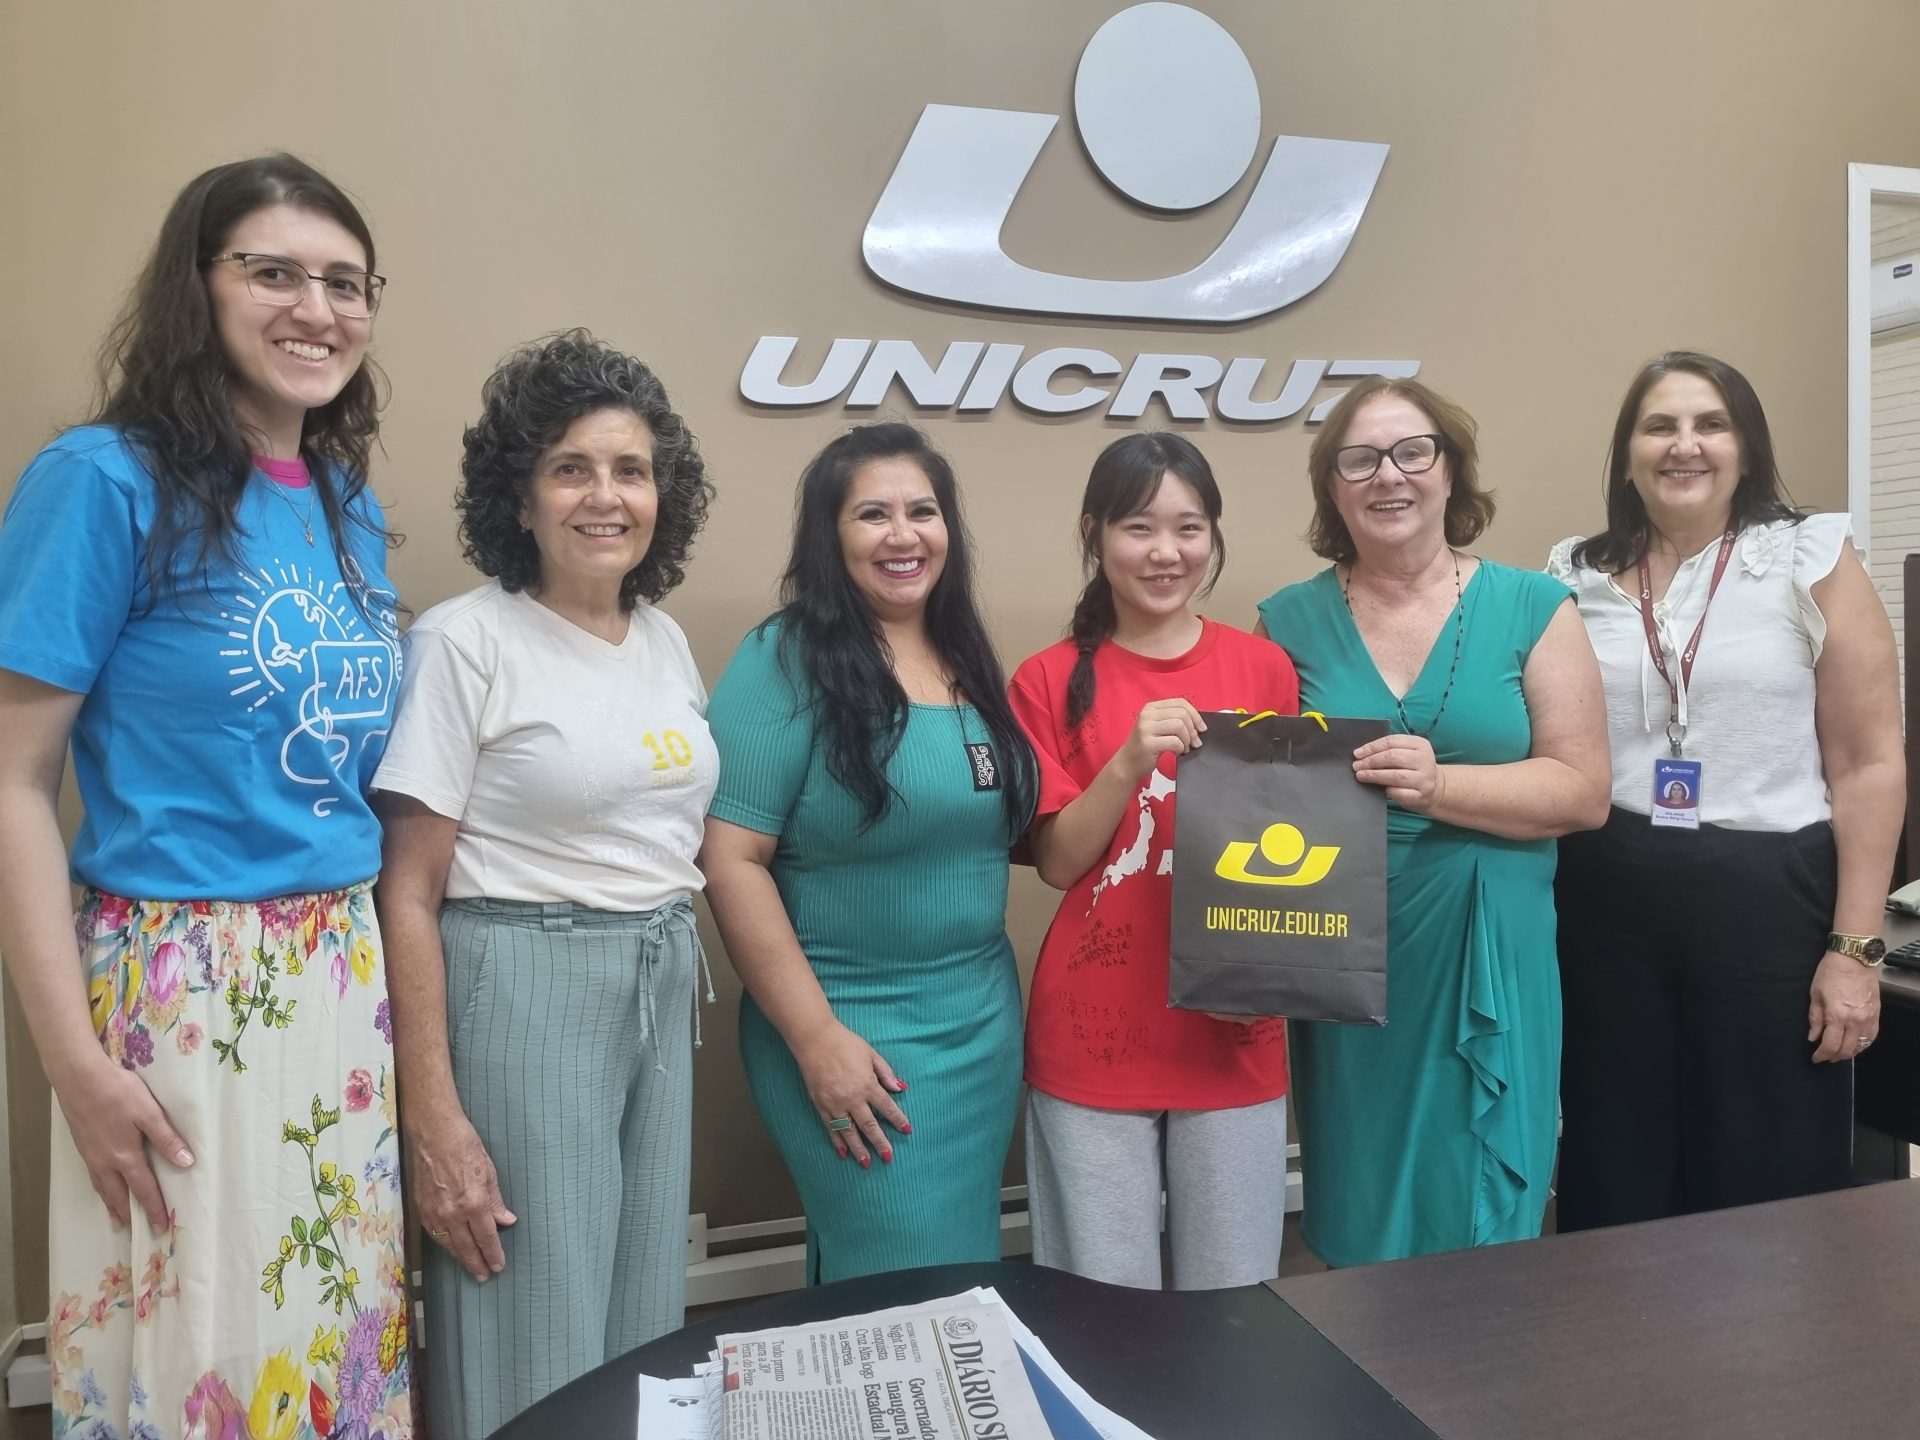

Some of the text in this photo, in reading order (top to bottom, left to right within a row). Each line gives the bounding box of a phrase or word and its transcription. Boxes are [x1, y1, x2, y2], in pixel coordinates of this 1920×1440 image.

[335, 656, 383, 700] AFS
[641, 729, 693, 770] 10
[1206, 906, 1348, 938] UNICRUZ.EDU.BR
[754, 1341, 766, 1356] para
[771, 1340, 785, 1381] Tudo pronto
[837, 1330, 856, 1366] na estreia
[855, 1328, 875, 1379] Cruz Alta logo
[871, 1327, 888, 1360] conquista
[887, 1323, 907, 1361] Night Run
[741, 1342, 756, 1385] Feira do Peixe
[949, 1339, 999, 1419] DIÁRIO
[864, 1383, 890, 1433] Estadual
[886, 1380, 909, 1435] inaugura
